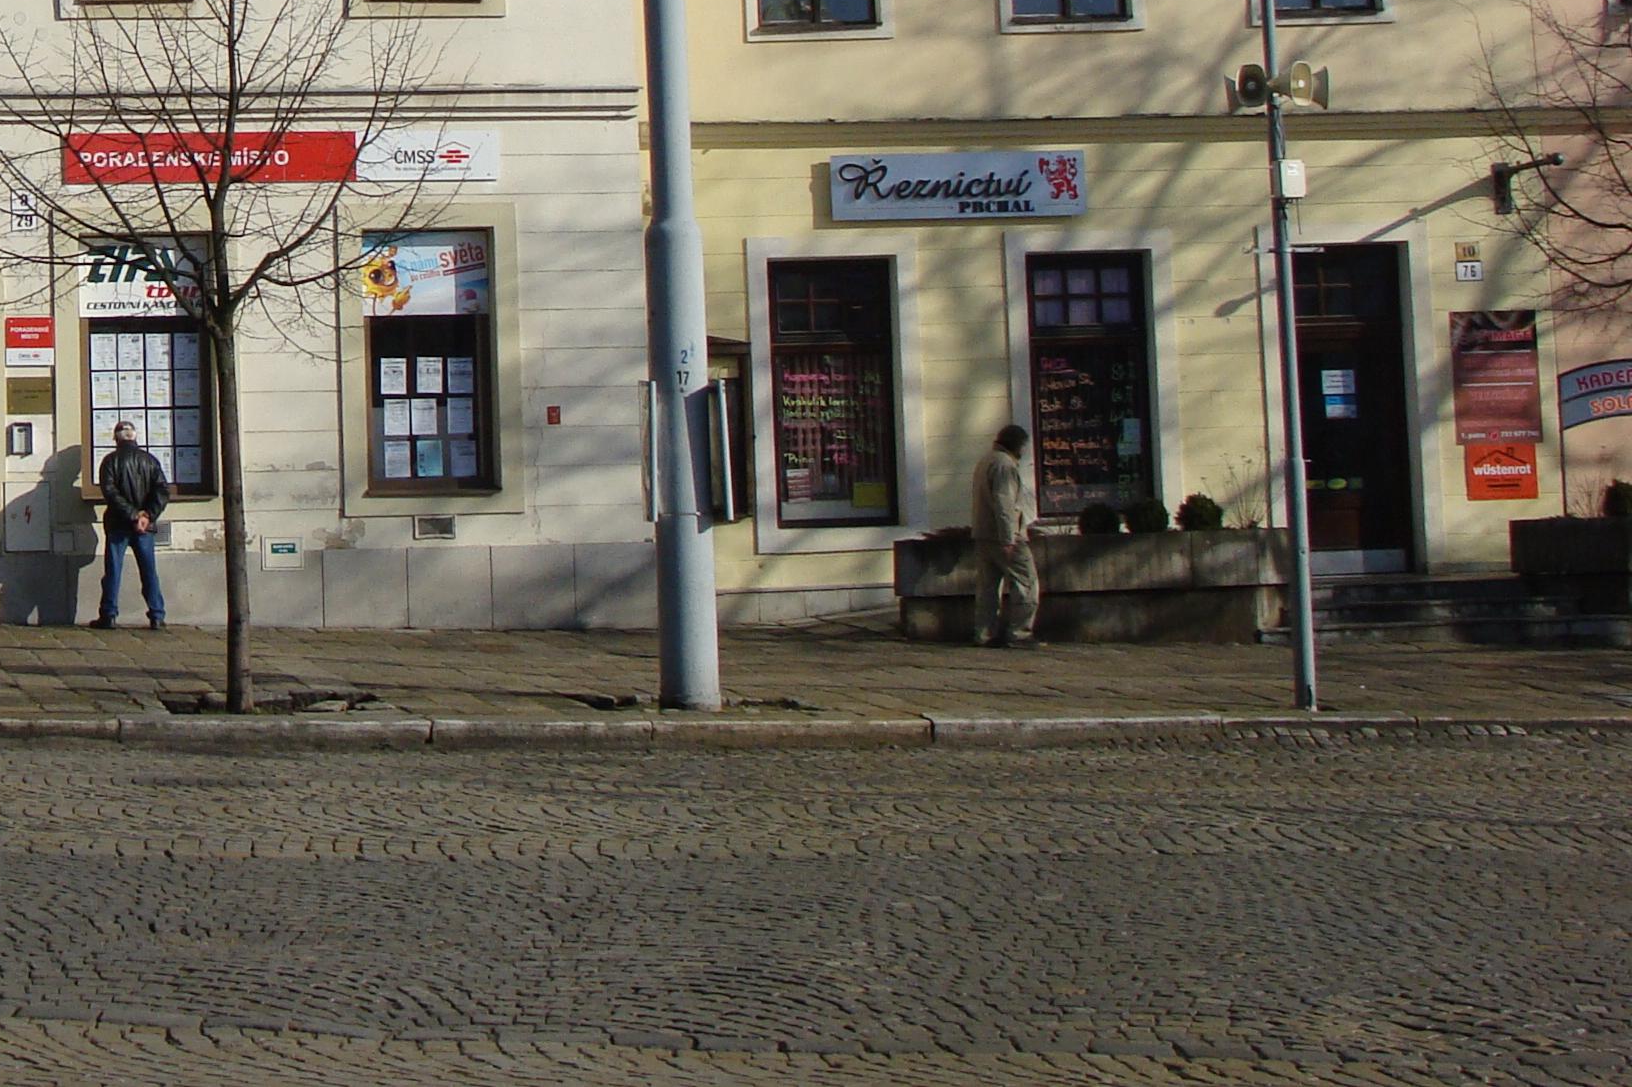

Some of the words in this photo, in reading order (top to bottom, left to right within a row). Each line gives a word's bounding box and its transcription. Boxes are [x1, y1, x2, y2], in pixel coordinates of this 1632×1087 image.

[394, 147, 435, 164] ČMSS
[838, 158, 1033, 201] Řeznictví
[957, 200, 1035, 213] PRCHAL
[440, 241, 486, 268] světa
[1462, 265, 1477, 278] 76
[680, 349, 688, 364] 2
[676, 370, 690, 386] 17
[1472, 463, 1532, 476] wüstenrot
